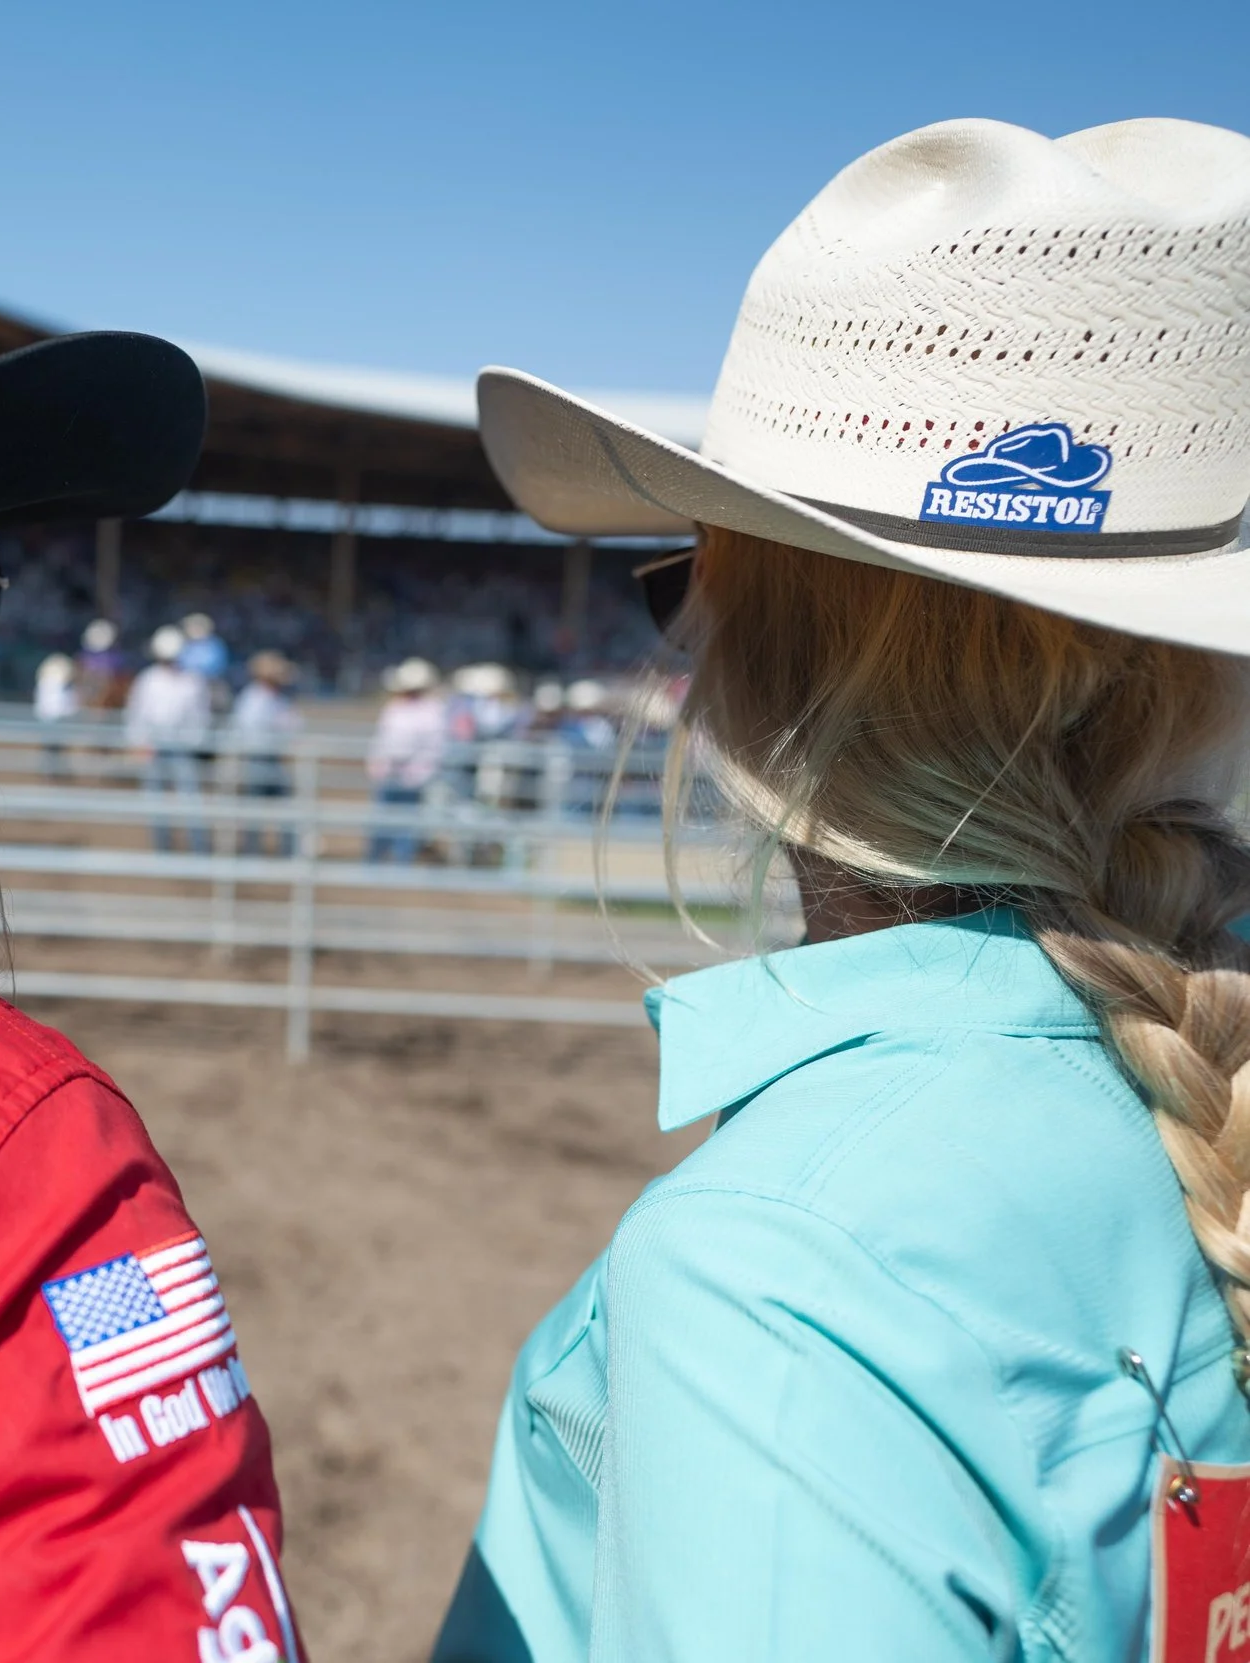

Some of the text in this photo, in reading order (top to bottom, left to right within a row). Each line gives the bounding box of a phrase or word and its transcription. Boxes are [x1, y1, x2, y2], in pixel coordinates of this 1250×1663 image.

[926, 488, 1096, 525] RESISTOL
[98, 1412, 149, 1464] In
[139, 1393, 210, 1447] God
[1205, 1581, 1250, 1663] PE
